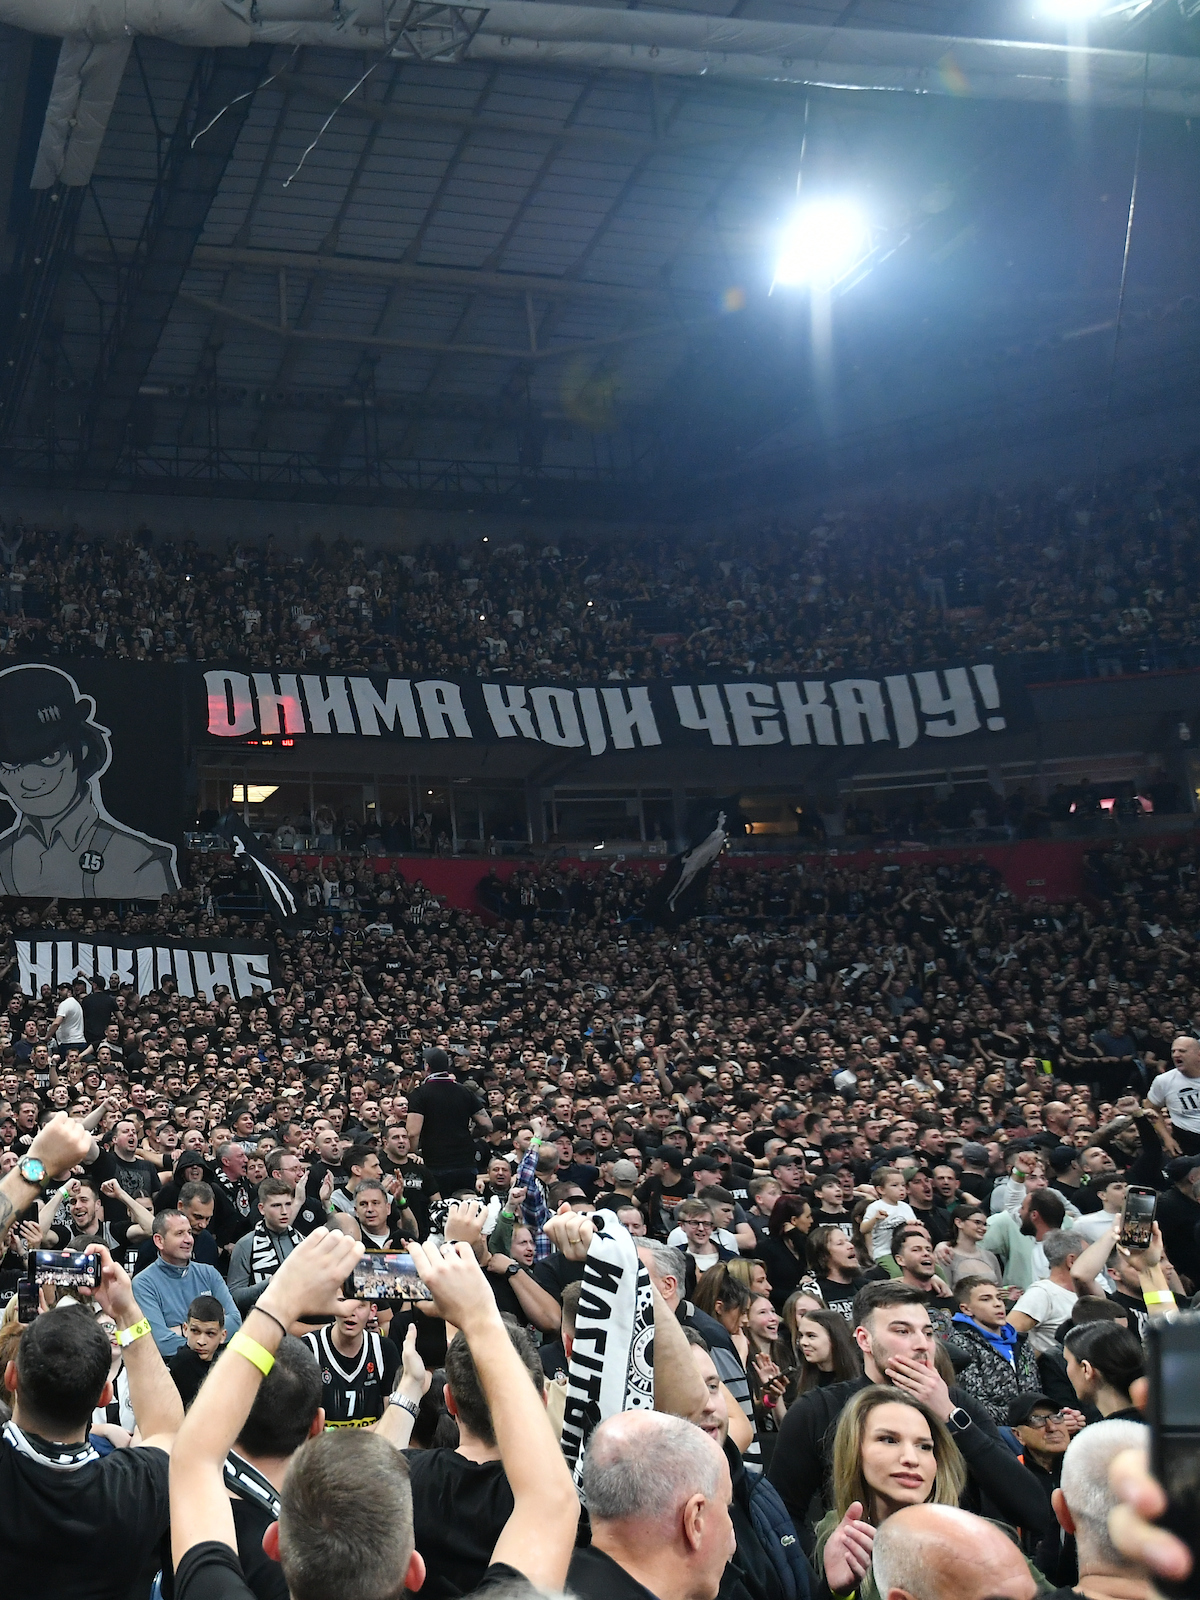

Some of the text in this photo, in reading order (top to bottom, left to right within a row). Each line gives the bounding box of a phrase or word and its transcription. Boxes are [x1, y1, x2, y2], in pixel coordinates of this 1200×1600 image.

[203, 665, 1005, 755] ОНИМА КОЈИ ЧЕКАЈУ!
[82, 853, 101, 870] 15
[345, 1390, 357, 1417] 7
